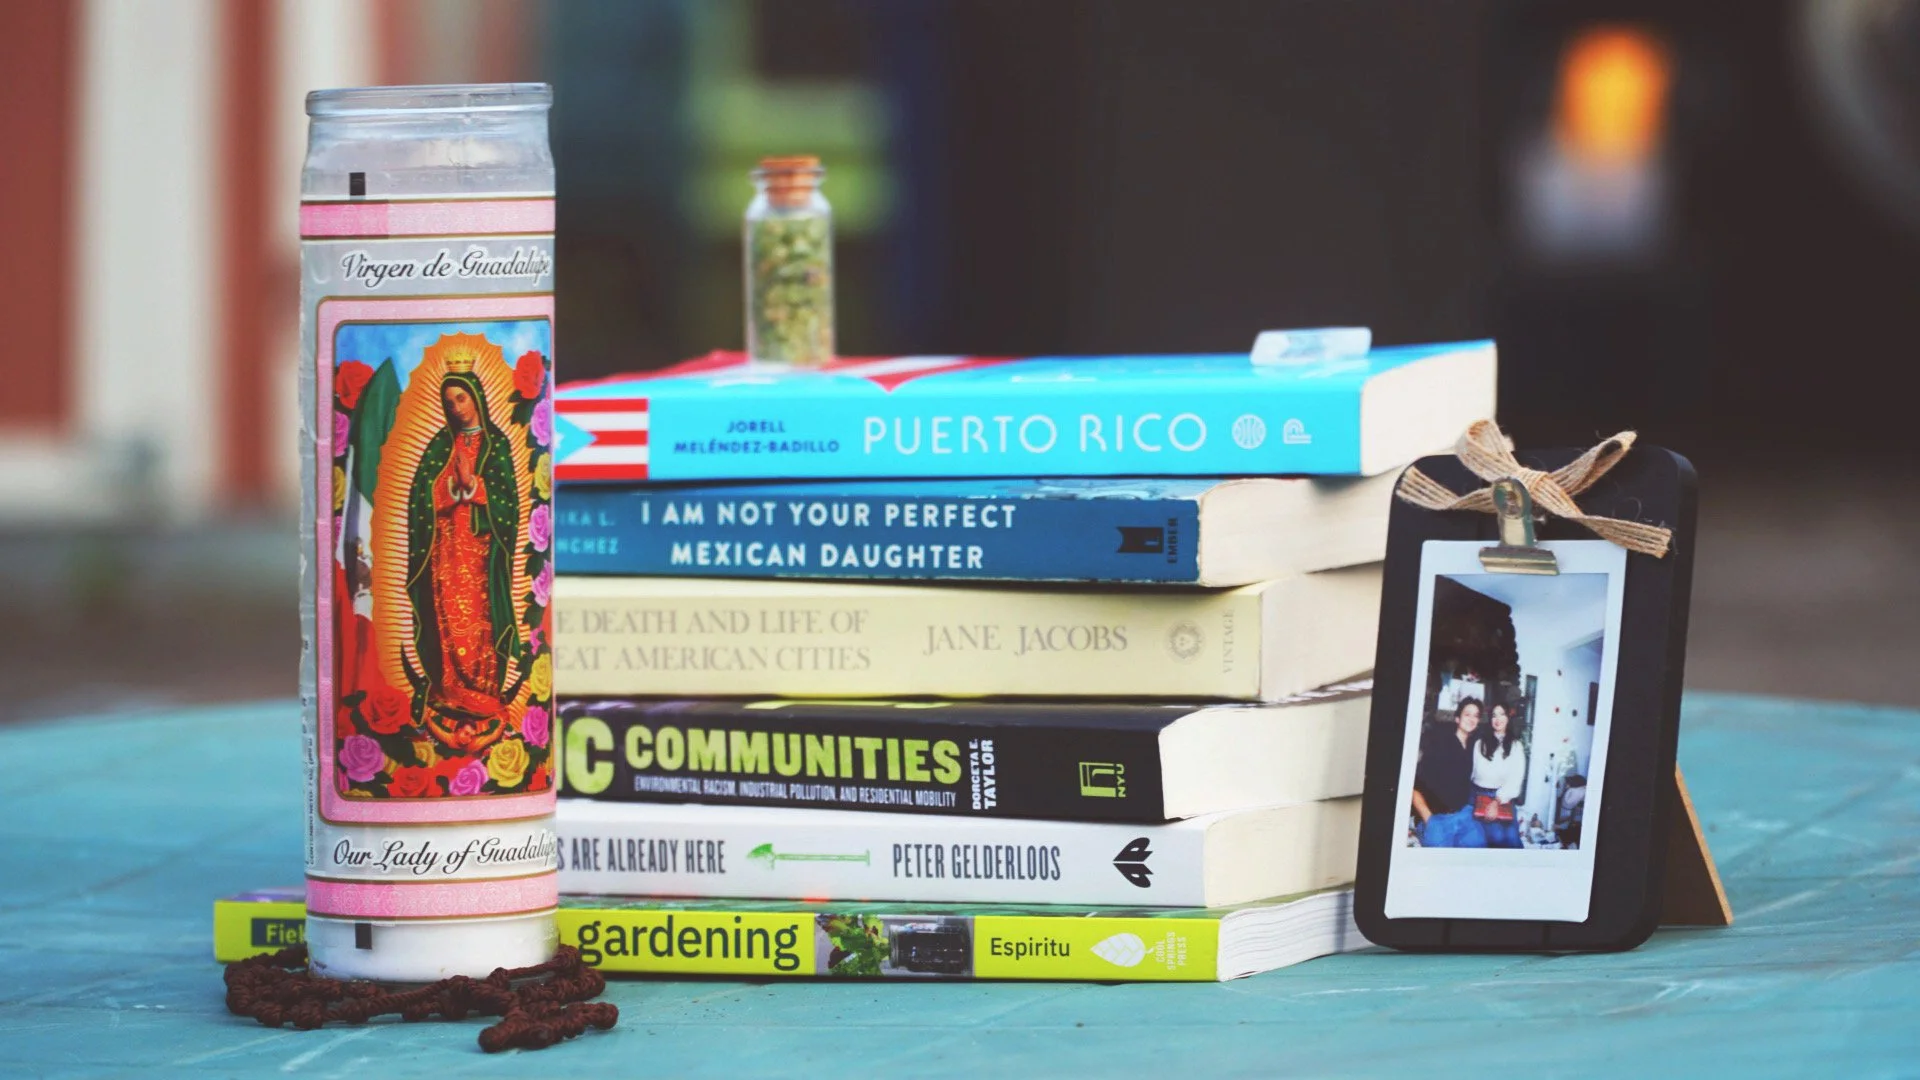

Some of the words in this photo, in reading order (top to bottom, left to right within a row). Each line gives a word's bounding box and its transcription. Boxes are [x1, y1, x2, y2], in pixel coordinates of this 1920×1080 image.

[341, 253, 414, 287] Virgen
[423, 253, 450, 277] de
[727, 421, 785, 433] JORELL
[863, 415, 1058, 455] PUERTO
[1080, 413, 1207, 452] RICO
[674, 439, 839, 454] MELÉNDEZ-BADILLO
[556, 511, 592, 527] IKA
[641, 502, 649, 523] I
[662, 502, 704, 525] AM
[718, 502, 776, 526] NOT
[789, 503, 870, 526] YOUR
[886, 504, 1016, 528] PERFECT
[556, 537, 618, 554] NCHEZ
[671, 543, 806, 567] MEXICAN
[821, 545, 984, 569] DAUGHTER
[582, 609, 677, 634] DEATH
[686, 609, 750, 634] AND
[760, 609, 823, 634] LIFE
[830, 609, 870, 634] OF
[923, 624, 1000, 655] JANE
[1014, 624, 1128, 656] JACOBS
[1223, 609, 1235, 674] VINTAGE
[555, 647, 606, 671] EAT
[614, 646, 768, 671] AMERICAN
[776, 646, 871, 671] CITIES
[624, 724, 961, 785] COMMUNITIES
[972, 753, 982, 810] DORCETA
[981, 740, 997, 809] TAYLOR
[1116, 764, 1127, 798] NYU
[635, 775, 701, 794] ENVIRONMENTAL
[739, 781, 788, 799] INDUSTRIAL
[840, 786, 857, 802] AND
[859, 788, 913, 805] RESIDENTIAL
[915, 790, 956, 807] MOBILITY
[334, 840, 372, 865] Our
[373, 840, 440, 875] Lady
[442, 839, 479, 874] of
[572, 838, 601, 871] ARE
[607, 838, 678, 873] ALREADY
[685, 840, 726, 874] HERE
[893, 843, 945, 879] PETER
[952, 844, 1061, 881] GELDERLOOS
[266, 923, 304, 944] Fiel
[577, 914, 800, 971] gardening
[991, 937, 1070, 960] Espiritu
[1156, 939, 1165, 963] COOL
[1167, 931, 1176, 970] SPRINGS
[1177, 936, 1187, 966] PRESS
